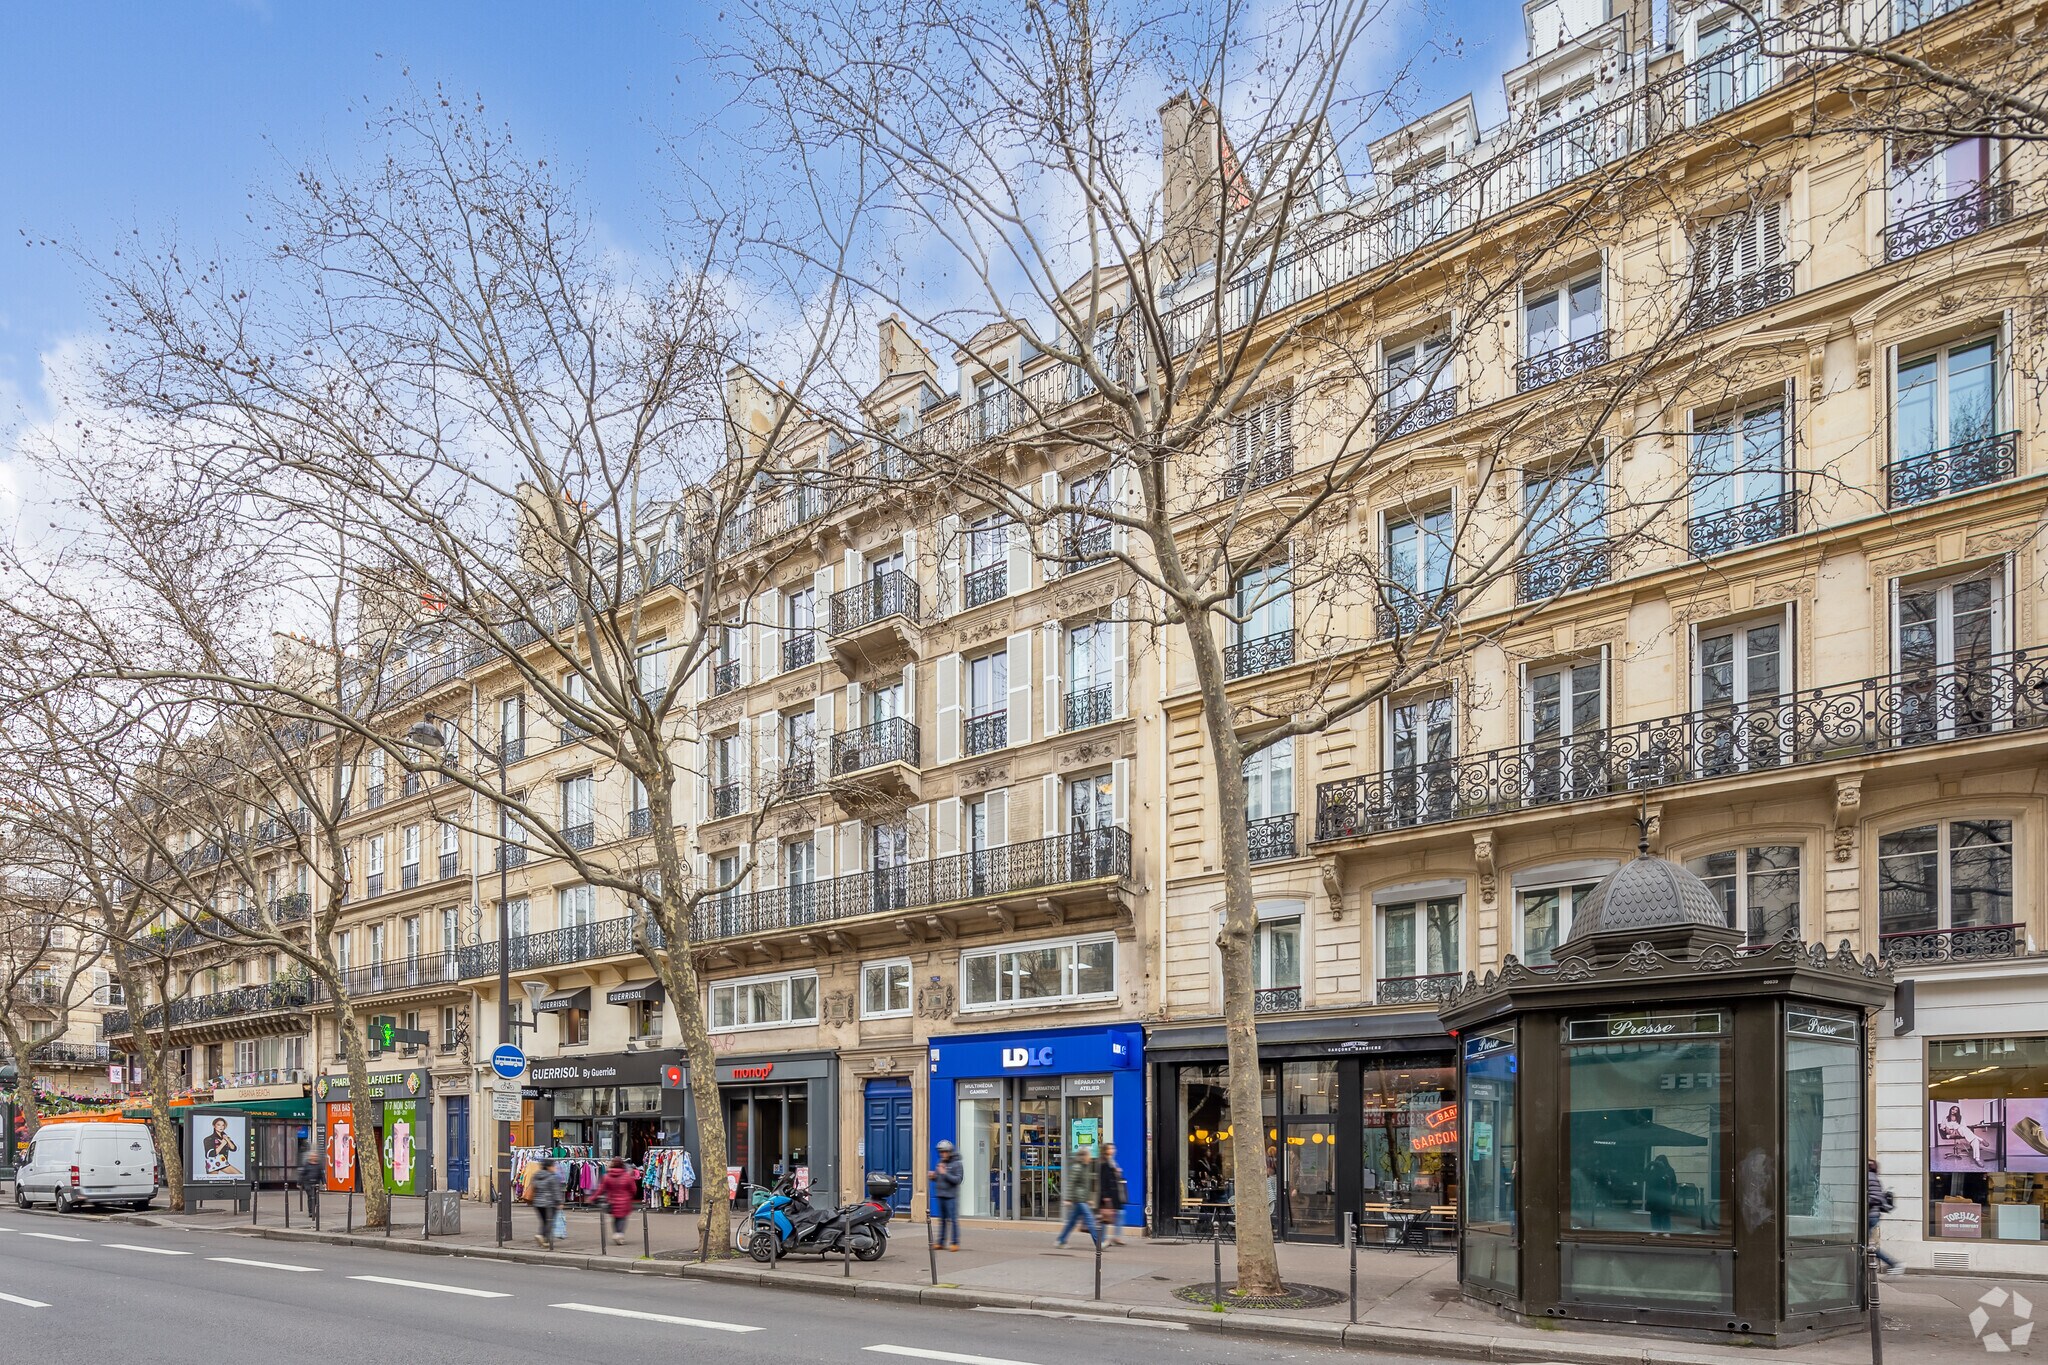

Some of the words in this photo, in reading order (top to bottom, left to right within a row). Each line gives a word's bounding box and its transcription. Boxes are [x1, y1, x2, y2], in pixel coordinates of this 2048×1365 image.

[610, 990, 642, 1001] GUERRISOL
[540, 1001, 569, 1010] GUERRISOL
[1611, 1020, 1676, 1036] Presse
[1807, 1017, 1837, 1035] Presse
[1478, 1037, 1499, 1051] Presse
[1003, 1047, 1053, 1067] LDLC
[532, 1067, 579, 1079] GUERRISOL
[583, 1069, 590, 1079] By
[591, 1067, 616, 1077] Guerrida
[368, 1074, 403, 1085] LAFAYETTE
[238, 1090, 254, 1098] CABANA
[332, 1104, 341, 1112] PRIX
[342, 1103, 350, 1111] BAS
[393, 1101, 404, 1110] NON
[1944, 1211, 1980, 1223] TORHILL
